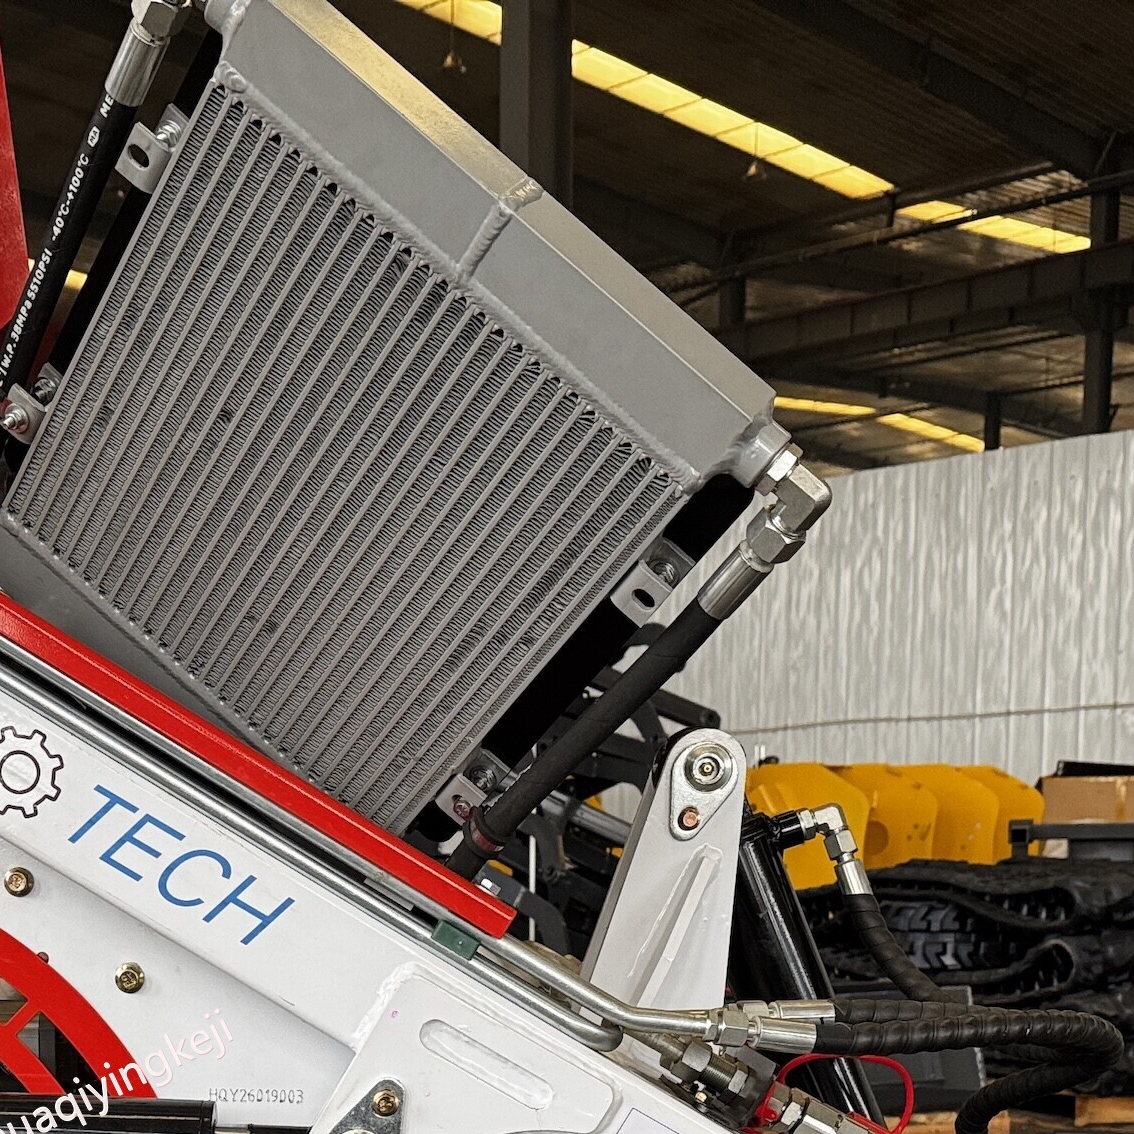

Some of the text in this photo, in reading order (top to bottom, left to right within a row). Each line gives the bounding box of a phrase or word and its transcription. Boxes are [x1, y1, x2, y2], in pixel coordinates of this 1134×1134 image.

[10, 299, 33, 342] 38MPa
[26, 247, 53, 301] 5510PSI
[67, 784, 296, 945] TECH
[209, 1088, 304, 1104] HQY26019003
